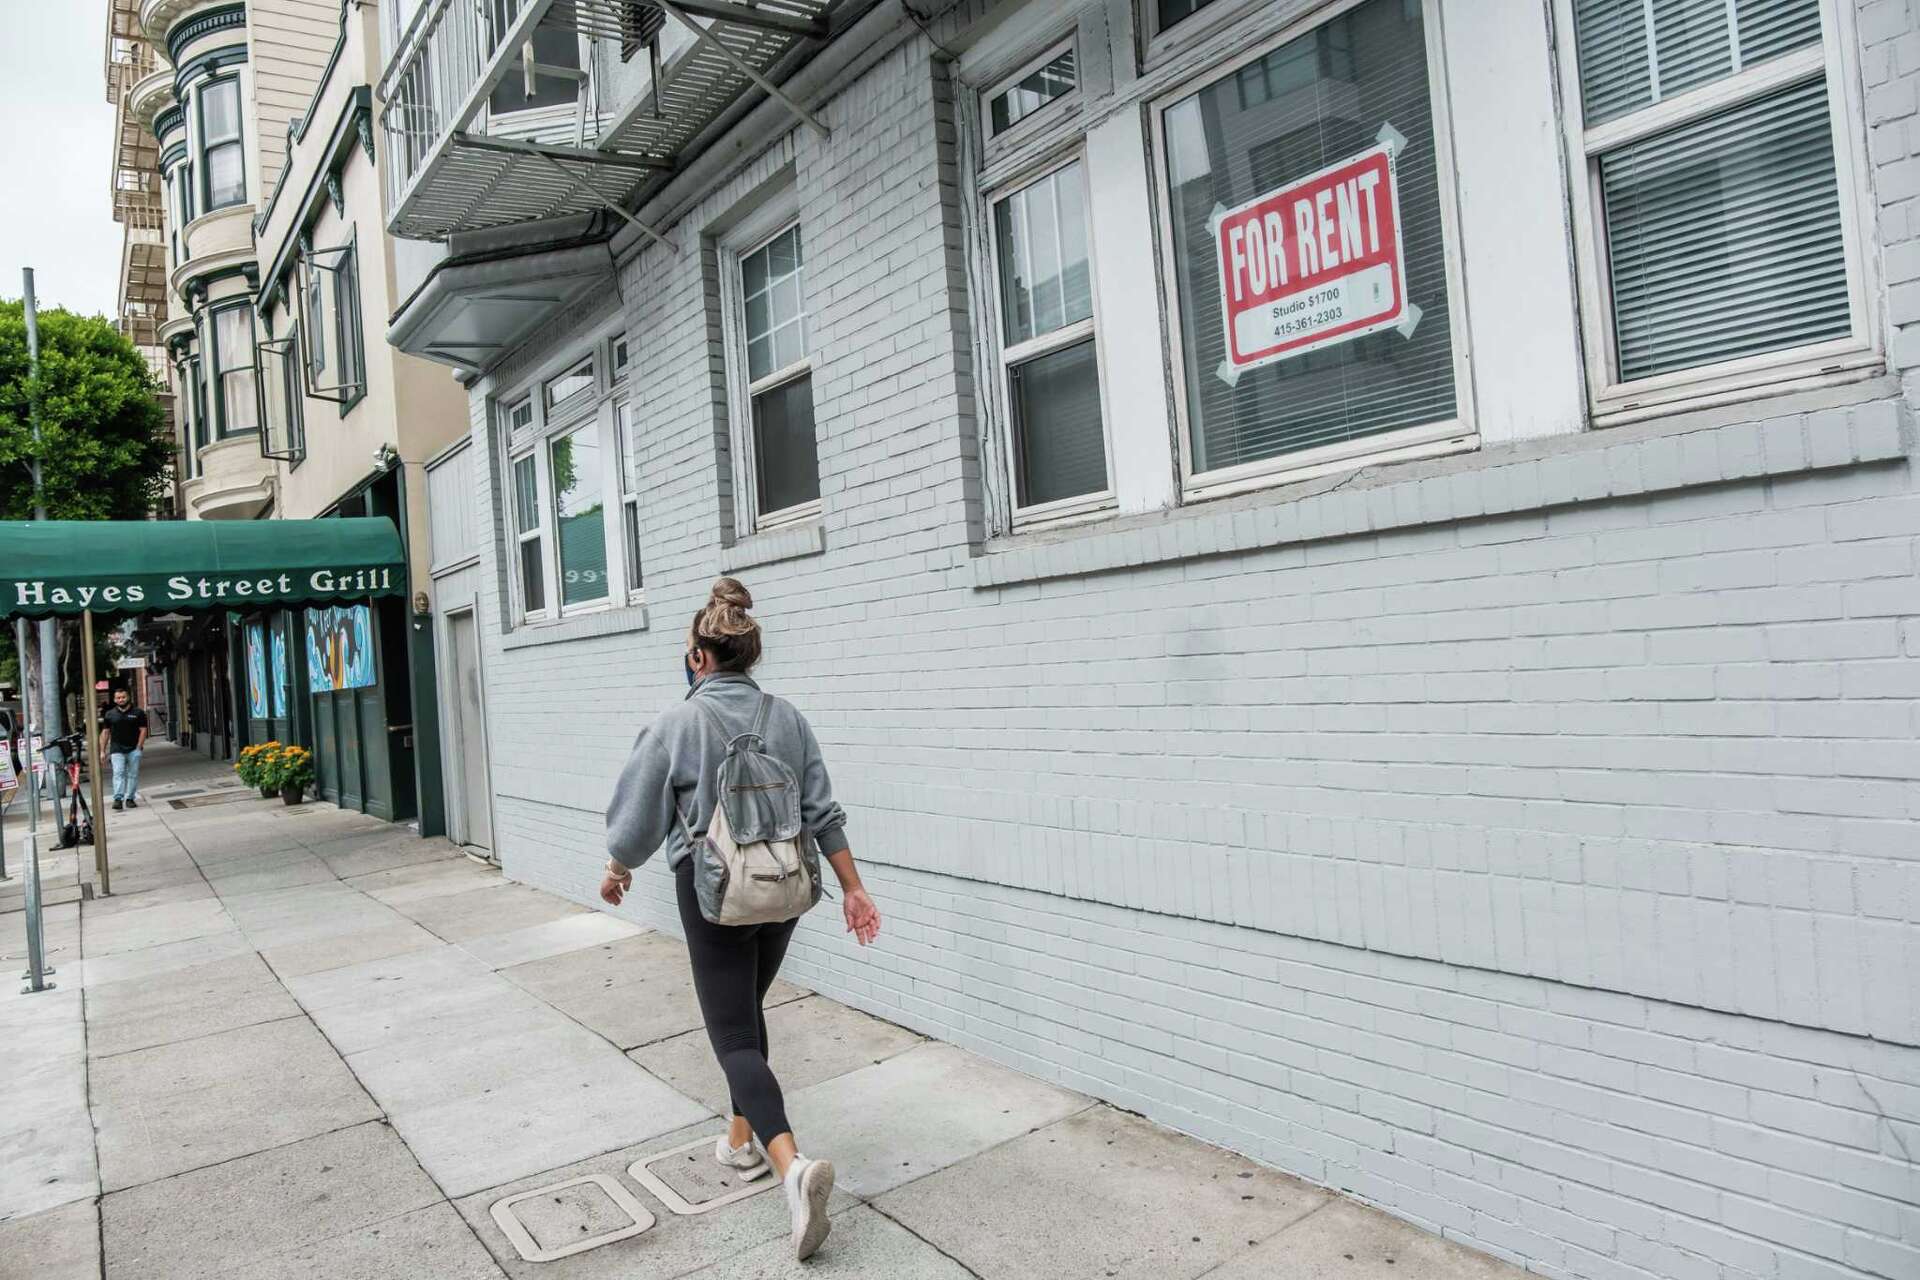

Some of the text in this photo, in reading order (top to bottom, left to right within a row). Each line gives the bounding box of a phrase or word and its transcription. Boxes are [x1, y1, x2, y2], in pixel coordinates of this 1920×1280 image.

[1229, 168, 1380, 302] FOR RENT
[1273, 287, 1340, 319] Studio $1700
[1274, 306, 1343, 336] 415-361-2303
[14, 568, 391, 607] Hayes Street Grill
